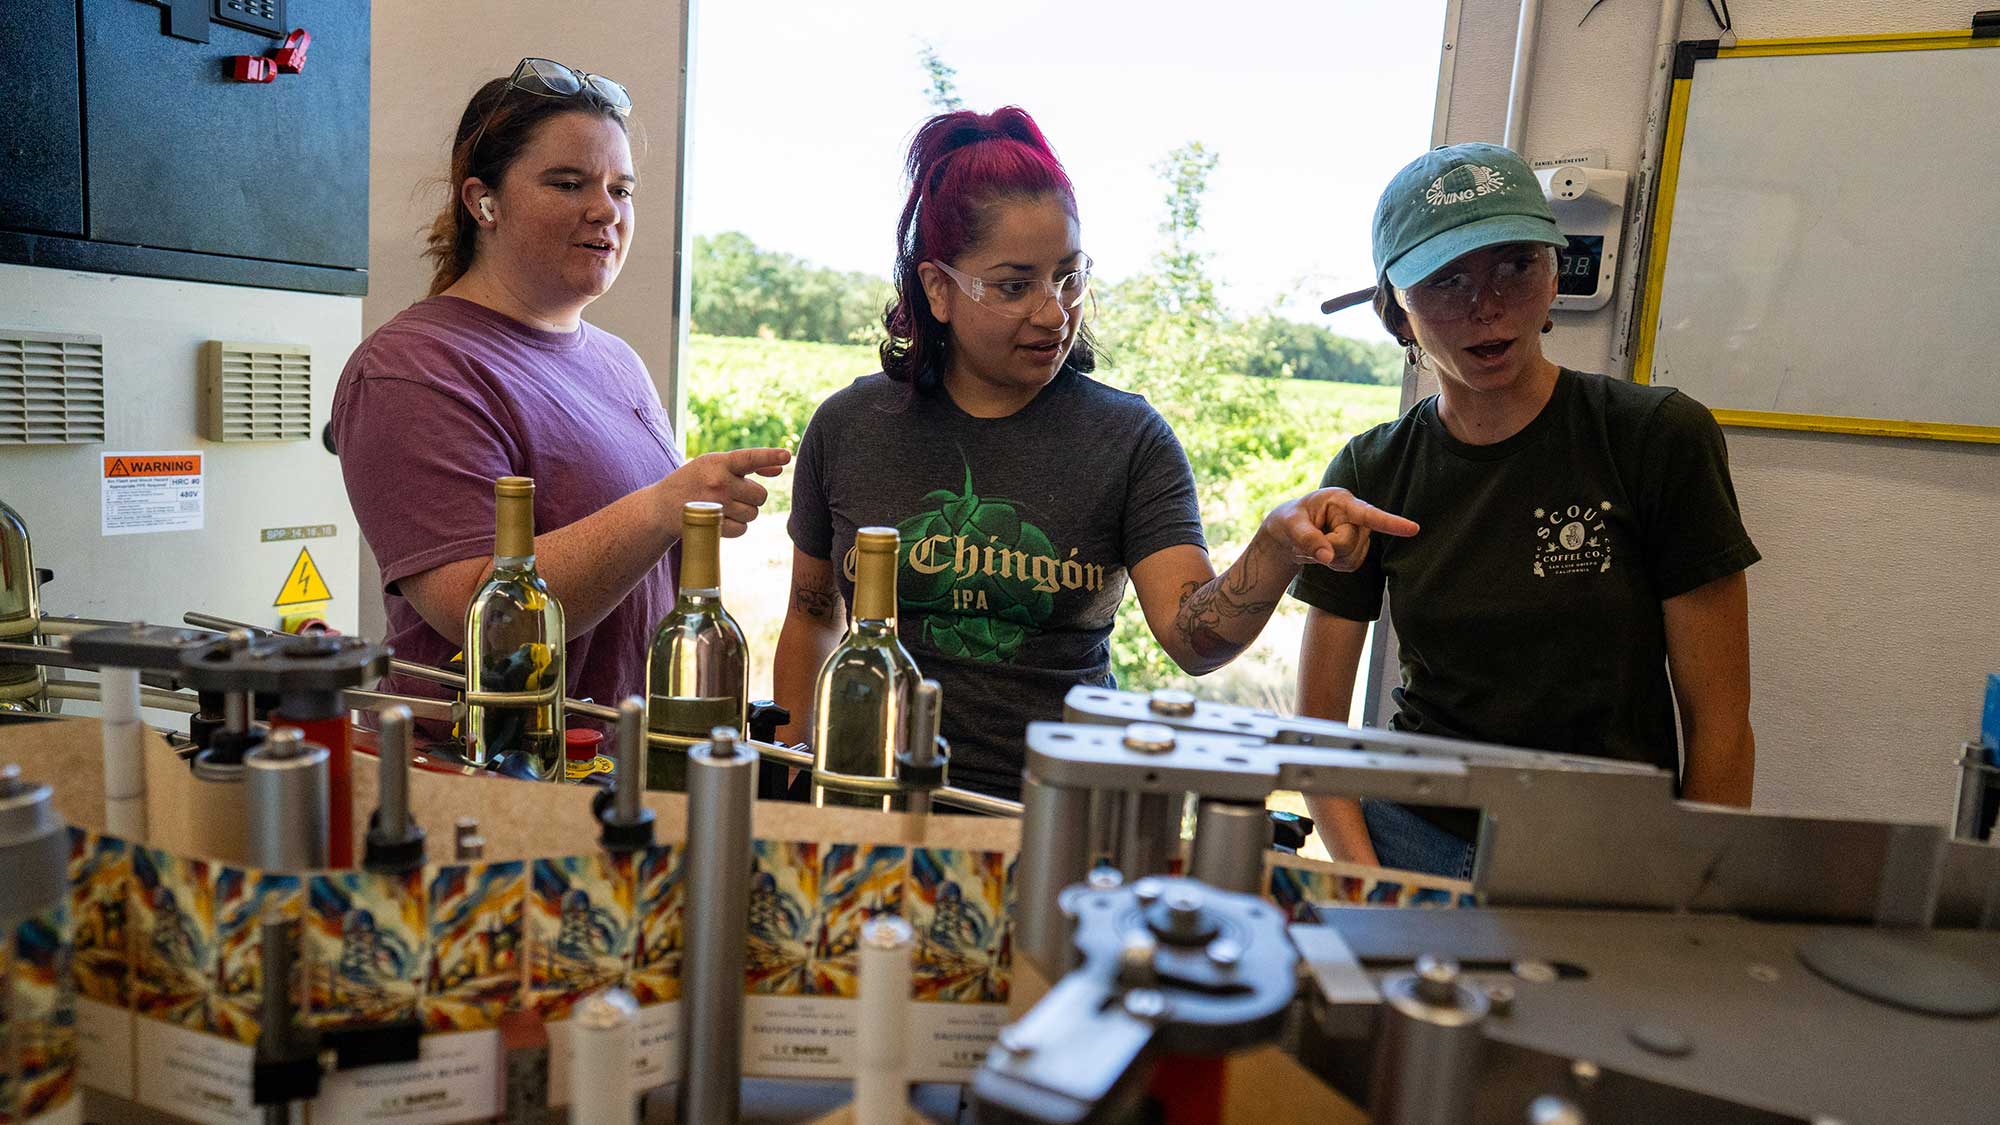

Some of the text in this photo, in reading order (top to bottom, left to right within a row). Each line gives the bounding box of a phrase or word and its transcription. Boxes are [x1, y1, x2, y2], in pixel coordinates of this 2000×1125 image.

[130, 461, 193, 472] WARNING
[180, 490, 198, 498] 480V
[1537, 505, 1606, 539] SCOUT
[909, 534, 1104, 593] Chingón
[1543, 553, 1582, 562] COFFEE
[953, 589, 989, 610] IPA
